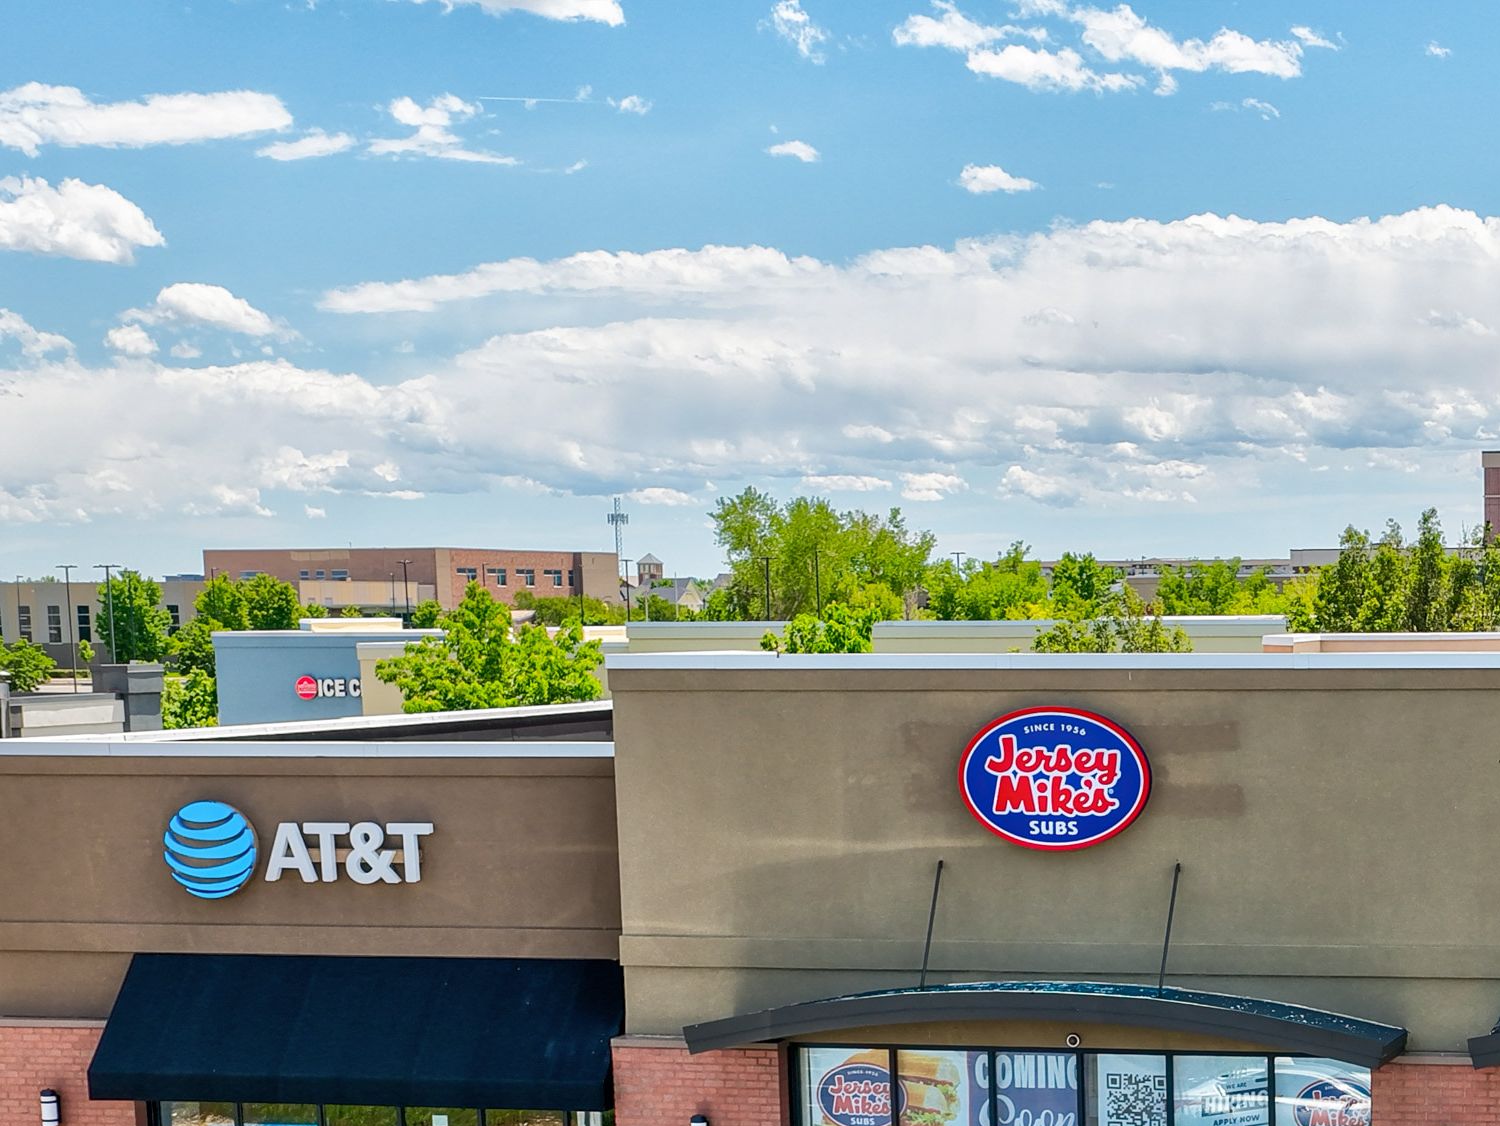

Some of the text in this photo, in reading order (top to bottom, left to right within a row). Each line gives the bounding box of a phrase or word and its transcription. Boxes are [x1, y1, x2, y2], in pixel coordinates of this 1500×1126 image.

[317, 678, 346, 697] ICE
[349, 678, 362, 697] C
[1024, 724, 1086, 736] SINCE 1956
[985, 734, 1121, 787] Jersey
[993, 775, 1119, 817] Mike's
[1029, 821, 1078, 835] SUBS
[265, 821, 434, 885] AT&T
[851, 1117, 875, 1126] SUBS
[1213, 1114, 1260, 1126] APPLY NOW
